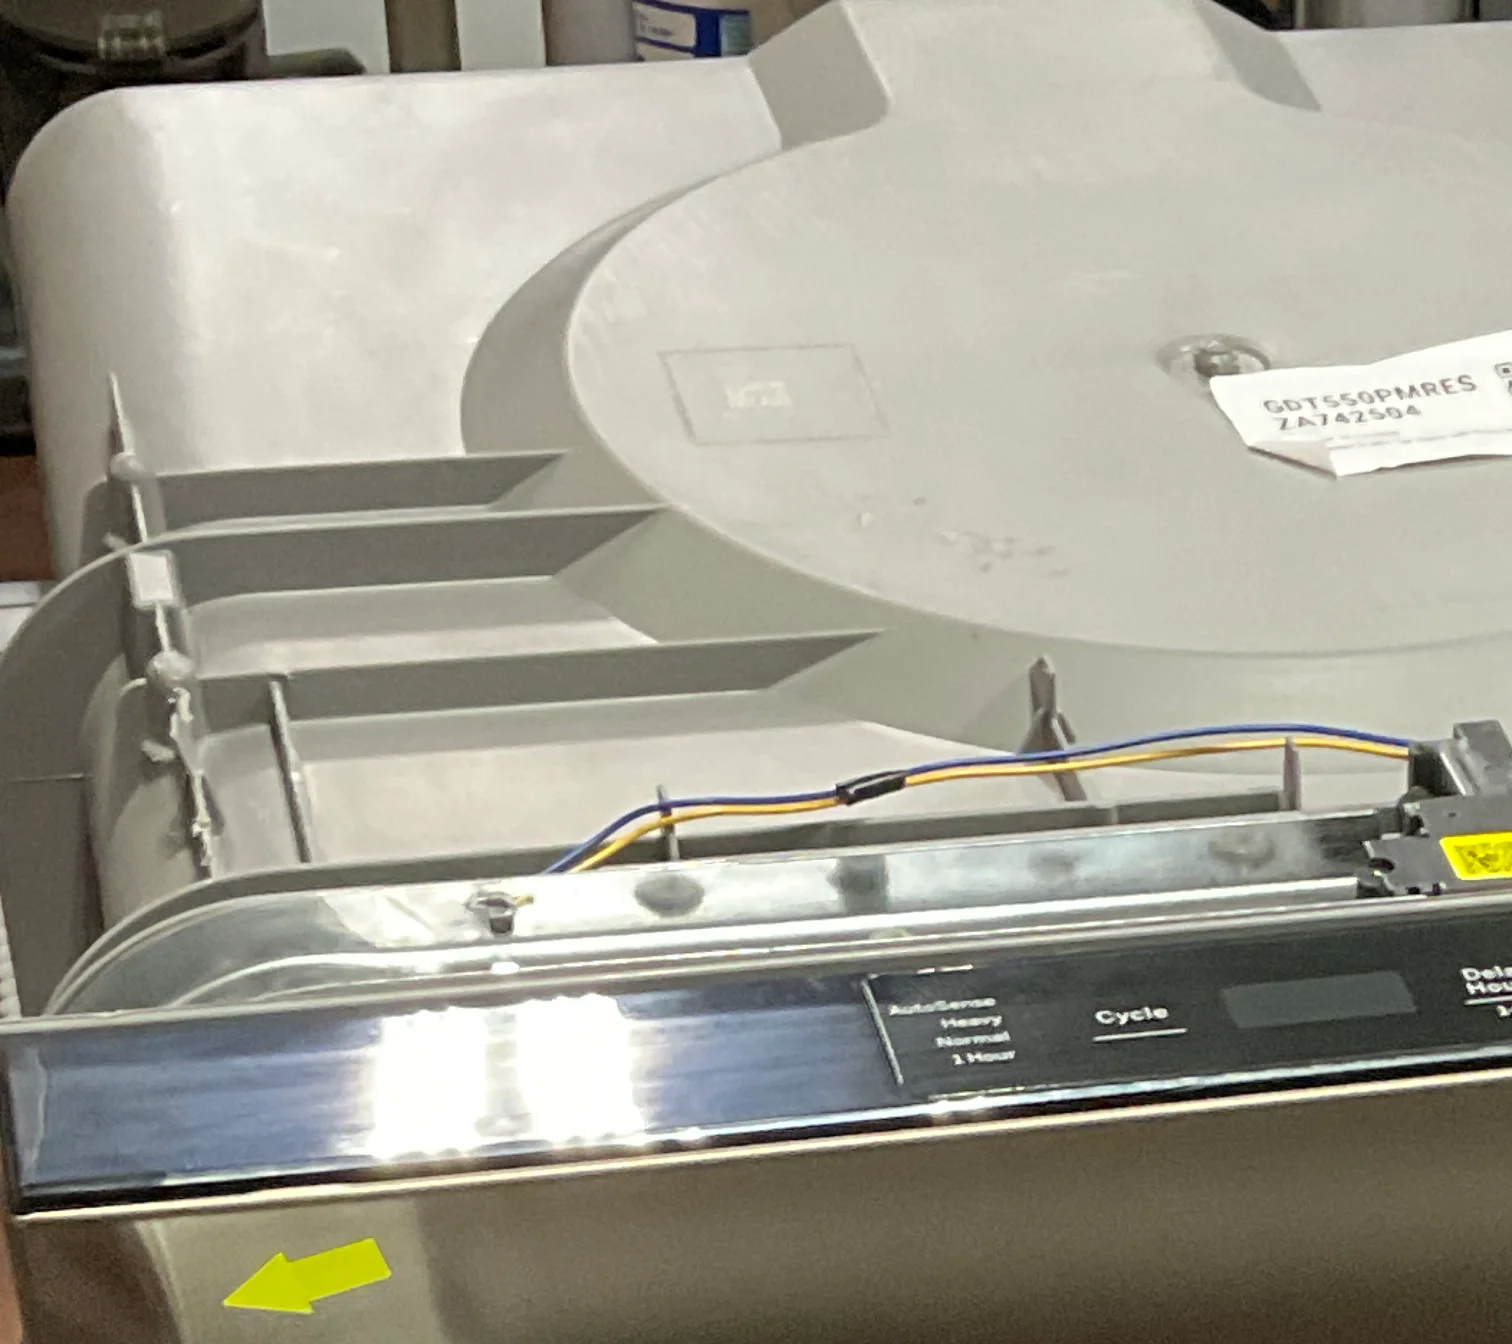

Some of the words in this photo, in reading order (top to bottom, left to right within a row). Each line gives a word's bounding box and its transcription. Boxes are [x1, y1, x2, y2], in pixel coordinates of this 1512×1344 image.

[1263, 374, 1478, 415] GDT550PMRES
[1274, 404, 1422, 431] ZA742504
[940, 1015, 1003, 1029] Heavy
[1094, 1005, 1169, 1026] Cycle
[935, 1030, 1011, 1048] Normal
